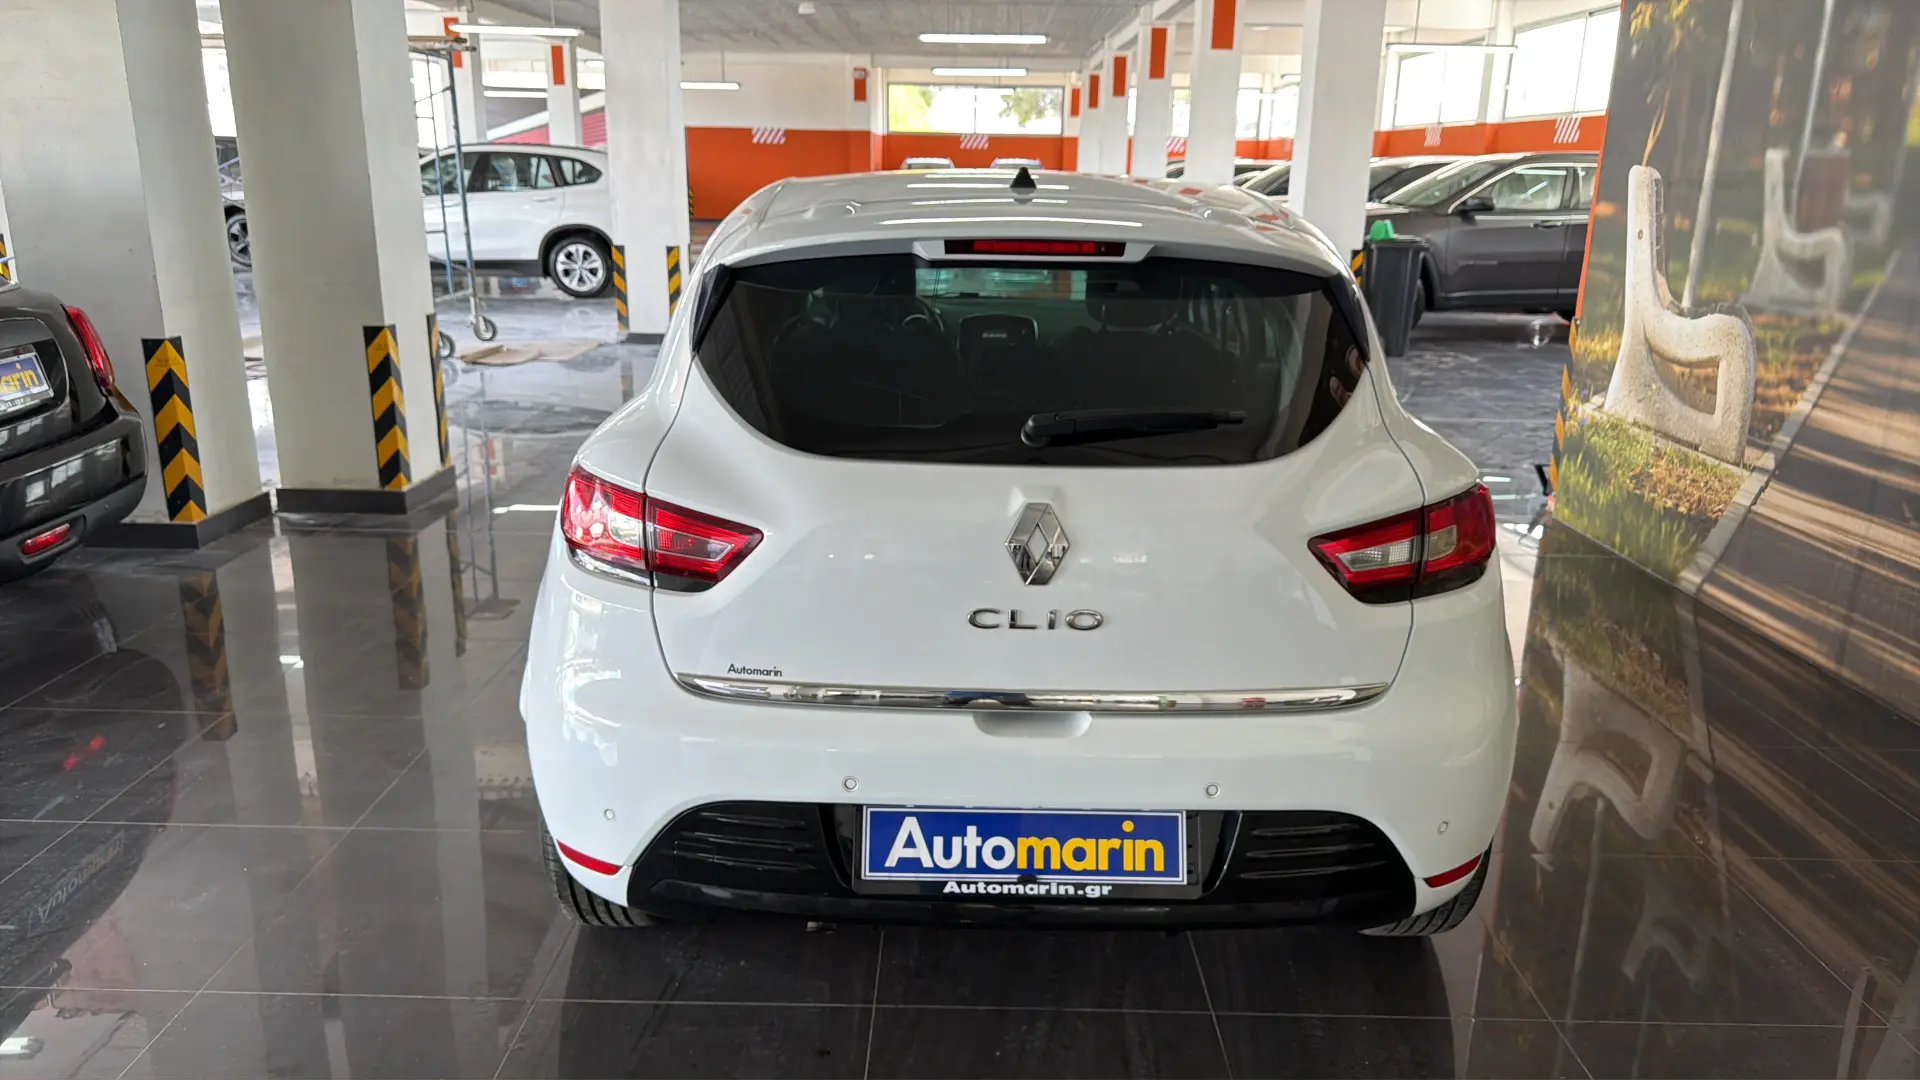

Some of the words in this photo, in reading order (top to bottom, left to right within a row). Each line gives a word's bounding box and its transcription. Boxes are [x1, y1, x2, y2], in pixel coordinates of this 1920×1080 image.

[0, 363, 39, 392] arin
[727, 663, 782, 677] Automarin
[884, 816, 1165, 872] Automarin
[943, 880, 1112, 898] Automarin.gr
